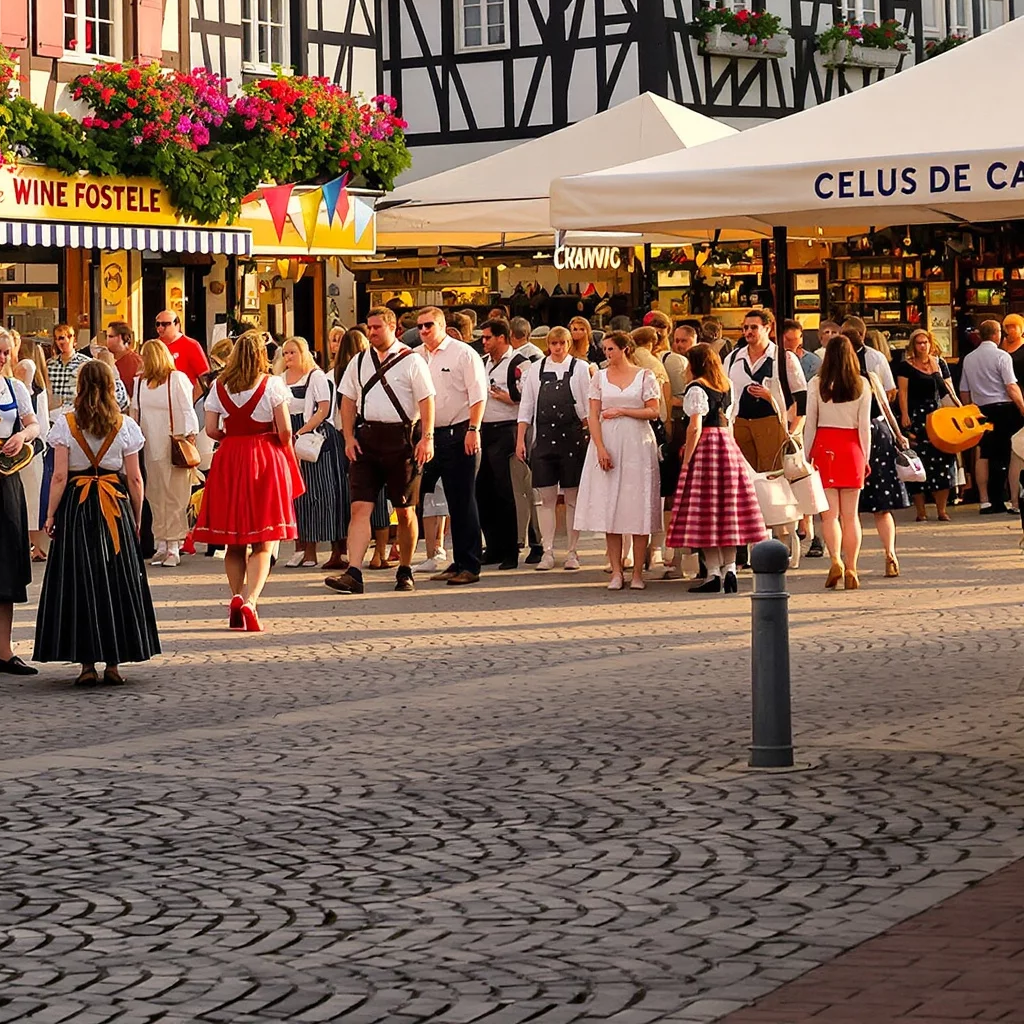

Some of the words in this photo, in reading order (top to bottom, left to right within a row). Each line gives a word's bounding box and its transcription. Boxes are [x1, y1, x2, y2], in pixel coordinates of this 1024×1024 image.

[13, 177, 68, 208] WINE
[75, 182, 161, 213] FOSTELE
[814, 167, 917, 199] CELUS
[930, 164, 972, 193] DE
